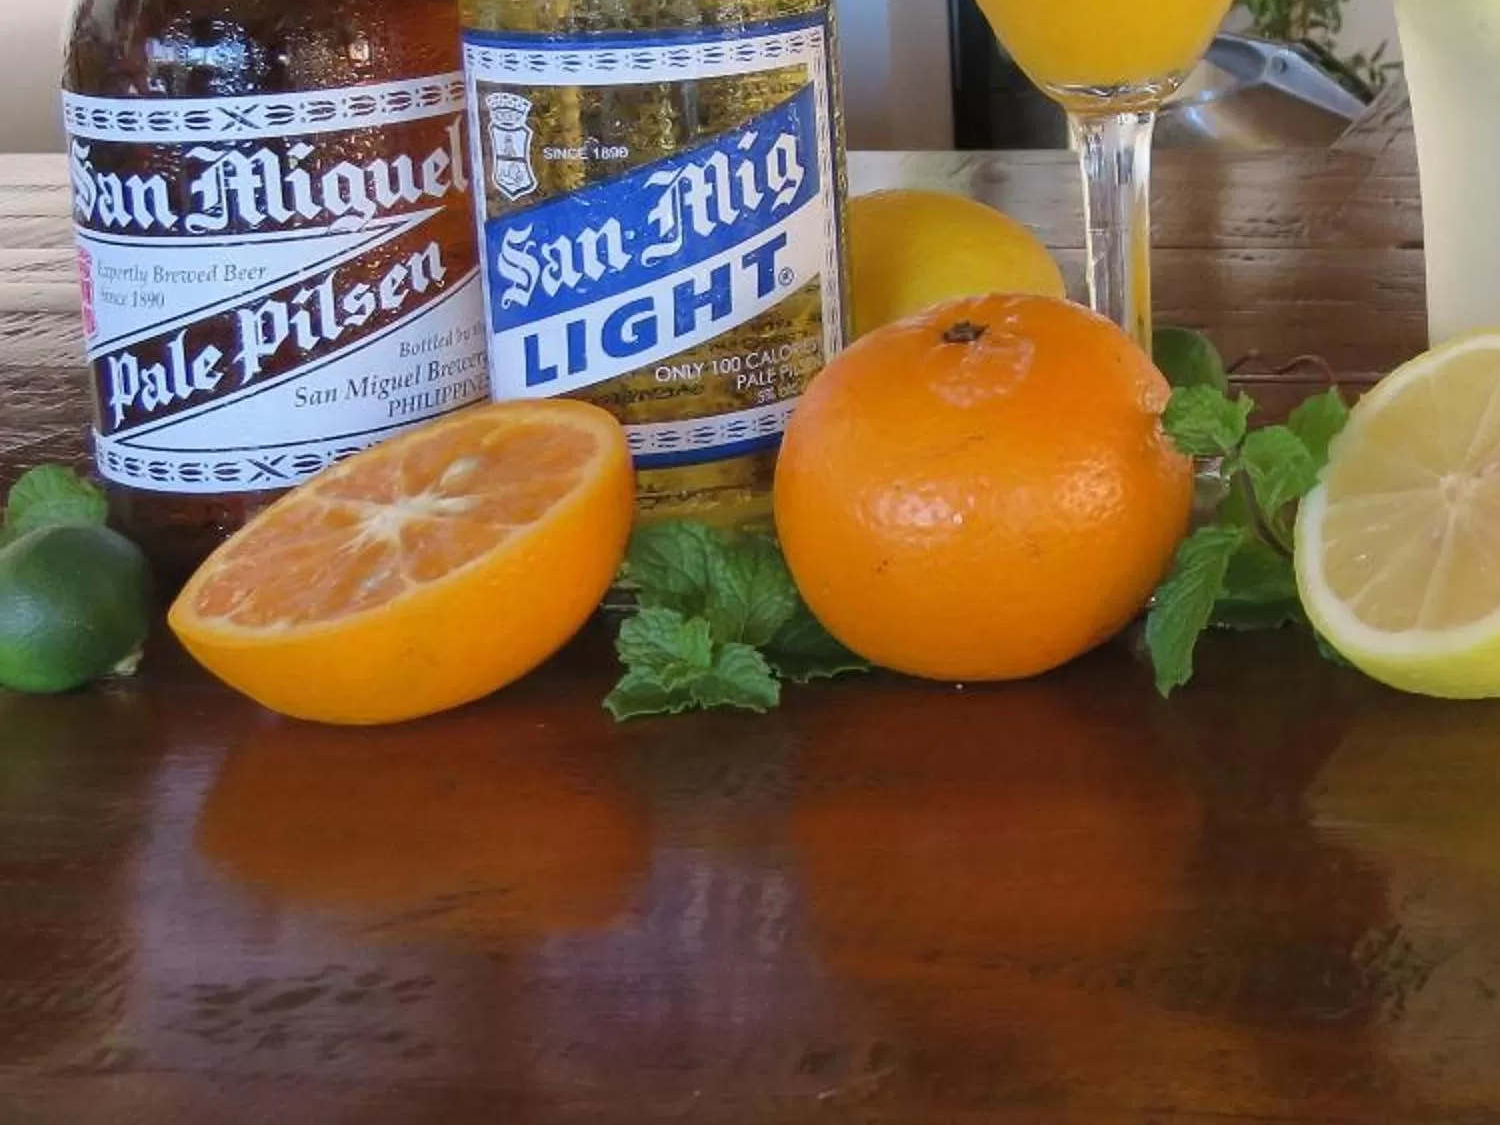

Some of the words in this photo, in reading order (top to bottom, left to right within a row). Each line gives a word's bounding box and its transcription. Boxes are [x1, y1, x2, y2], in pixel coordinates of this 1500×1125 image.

[542, 145, 588, 162] SINCE
[72, 138, 178, 230] San
[183, 114, 469, 235] Miguel
[497, 216, 633, 310] San
[640, 130, 805, 267] Mig
[153, 264, 218, 284] Brewed
[223, 263, 267, 282] Beer
[131, 289, 165, 308] 1890
[523, 230, 788, 388] LIGHT
[107, 328, 225, 430] Pale
[230, 239, 447, 385] Pilsen
[399, 329, 454, 358] Bottled
[655, 361, 706, 383] ONLY
[711, 355, 741, 375] 100
[736, 370, 777, 391] PALE
[294, 386, 338, 408] San
[343, 364, 421, 401] Miguel
